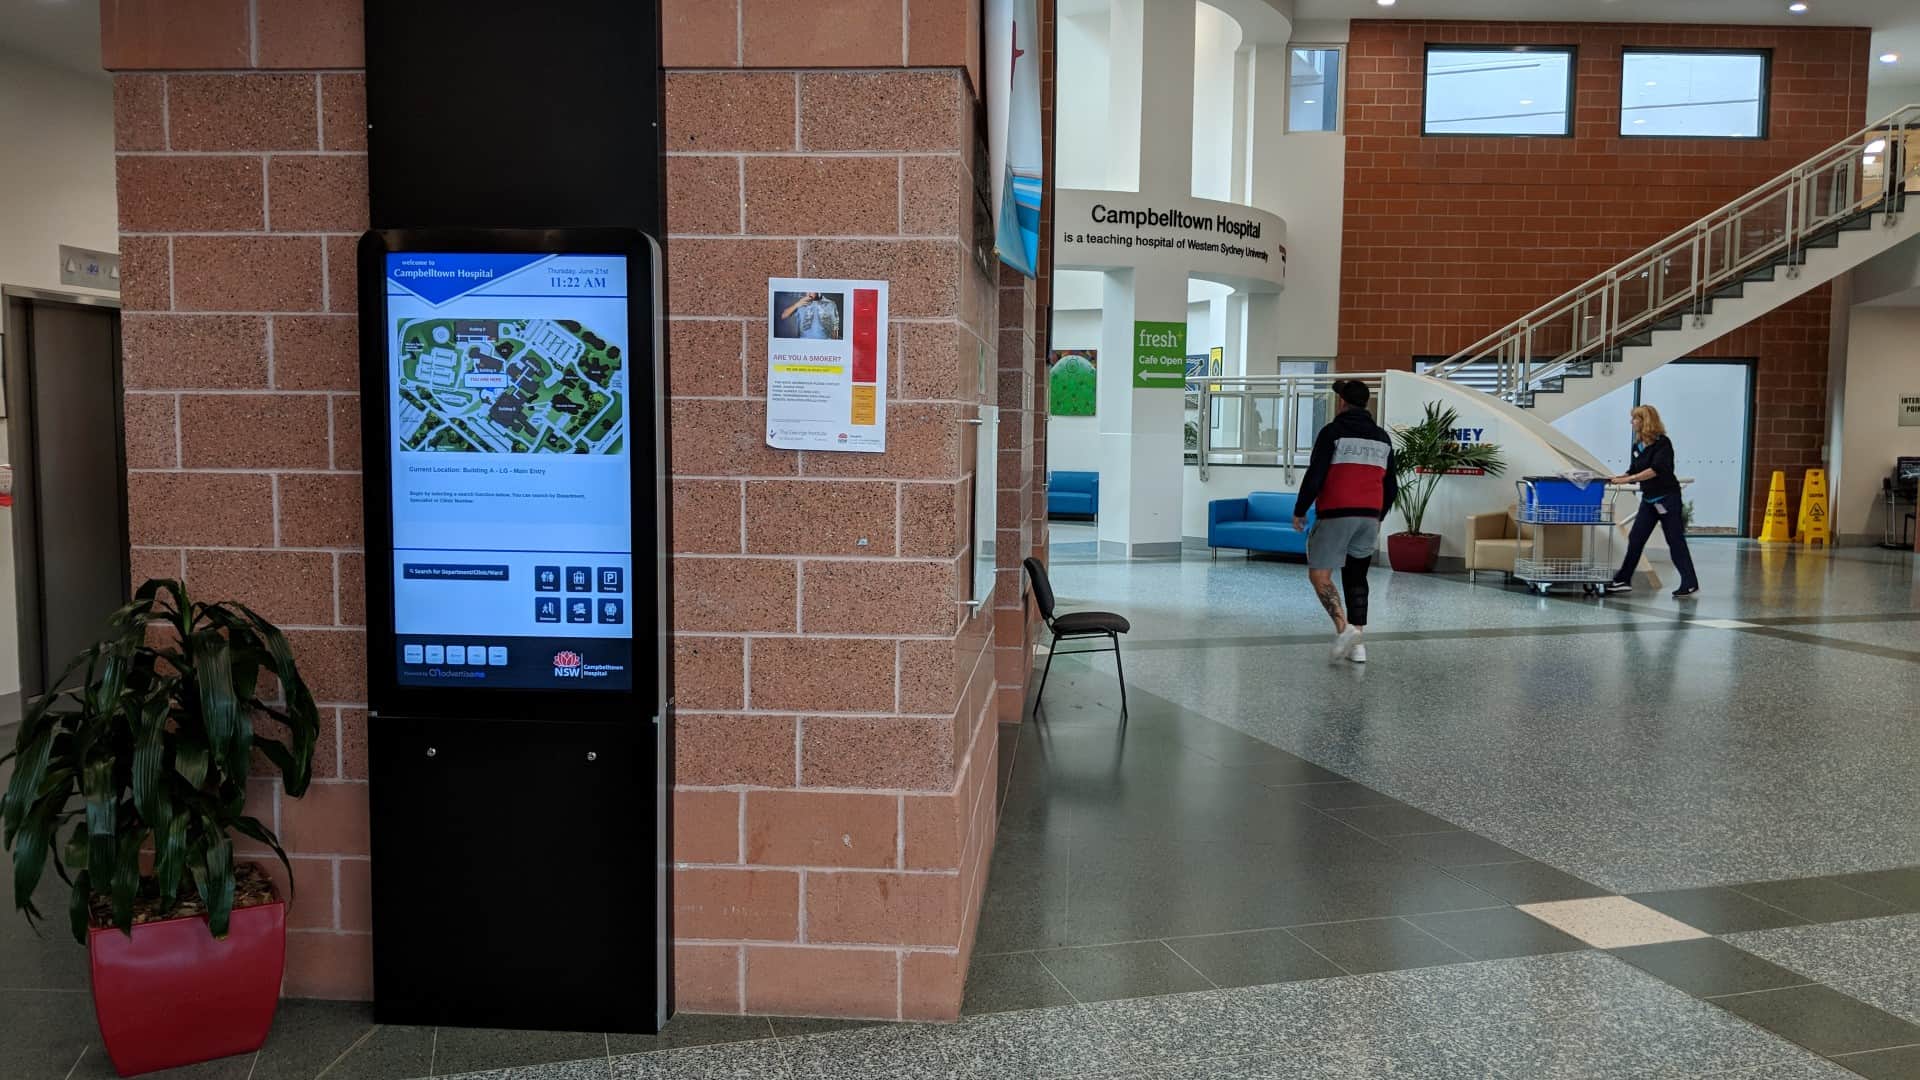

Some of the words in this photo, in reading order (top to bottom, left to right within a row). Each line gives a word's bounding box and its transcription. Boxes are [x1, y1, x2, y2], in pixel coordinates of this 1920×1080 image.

[1091, 204, 1213, 231] Campbelltown
[1217, 215, 1261, 240] Hospital
[1064, 232, 1073, 243] is
[1076, 234, 1083, 243] a
[1087, 233, 1133, 247] teaching
[1136, 235, 1174, 249] hospital
[1176, 239, 1186, 249] of
[1188, 239, 1219, 253] Western
[1221, 243, 1244, 258] Sydney
[1245, 247, 1269, 263] University
[393, 268, 455, 280] Campbelltown
[457, 268, 494, 280] Hospital
[551, 277, 580, 288] 11:22
[583, 277, 606, 288] AM
[1138, 355, 1158, 365] Cafe
[1160, 356, 1183, 366] Open
[462, 467, 488, 475] Building
[414, 568, 432, 576] Search
[554, 667, 580, 677] NSW
[583, 663, 624, 671] Campbelltown
